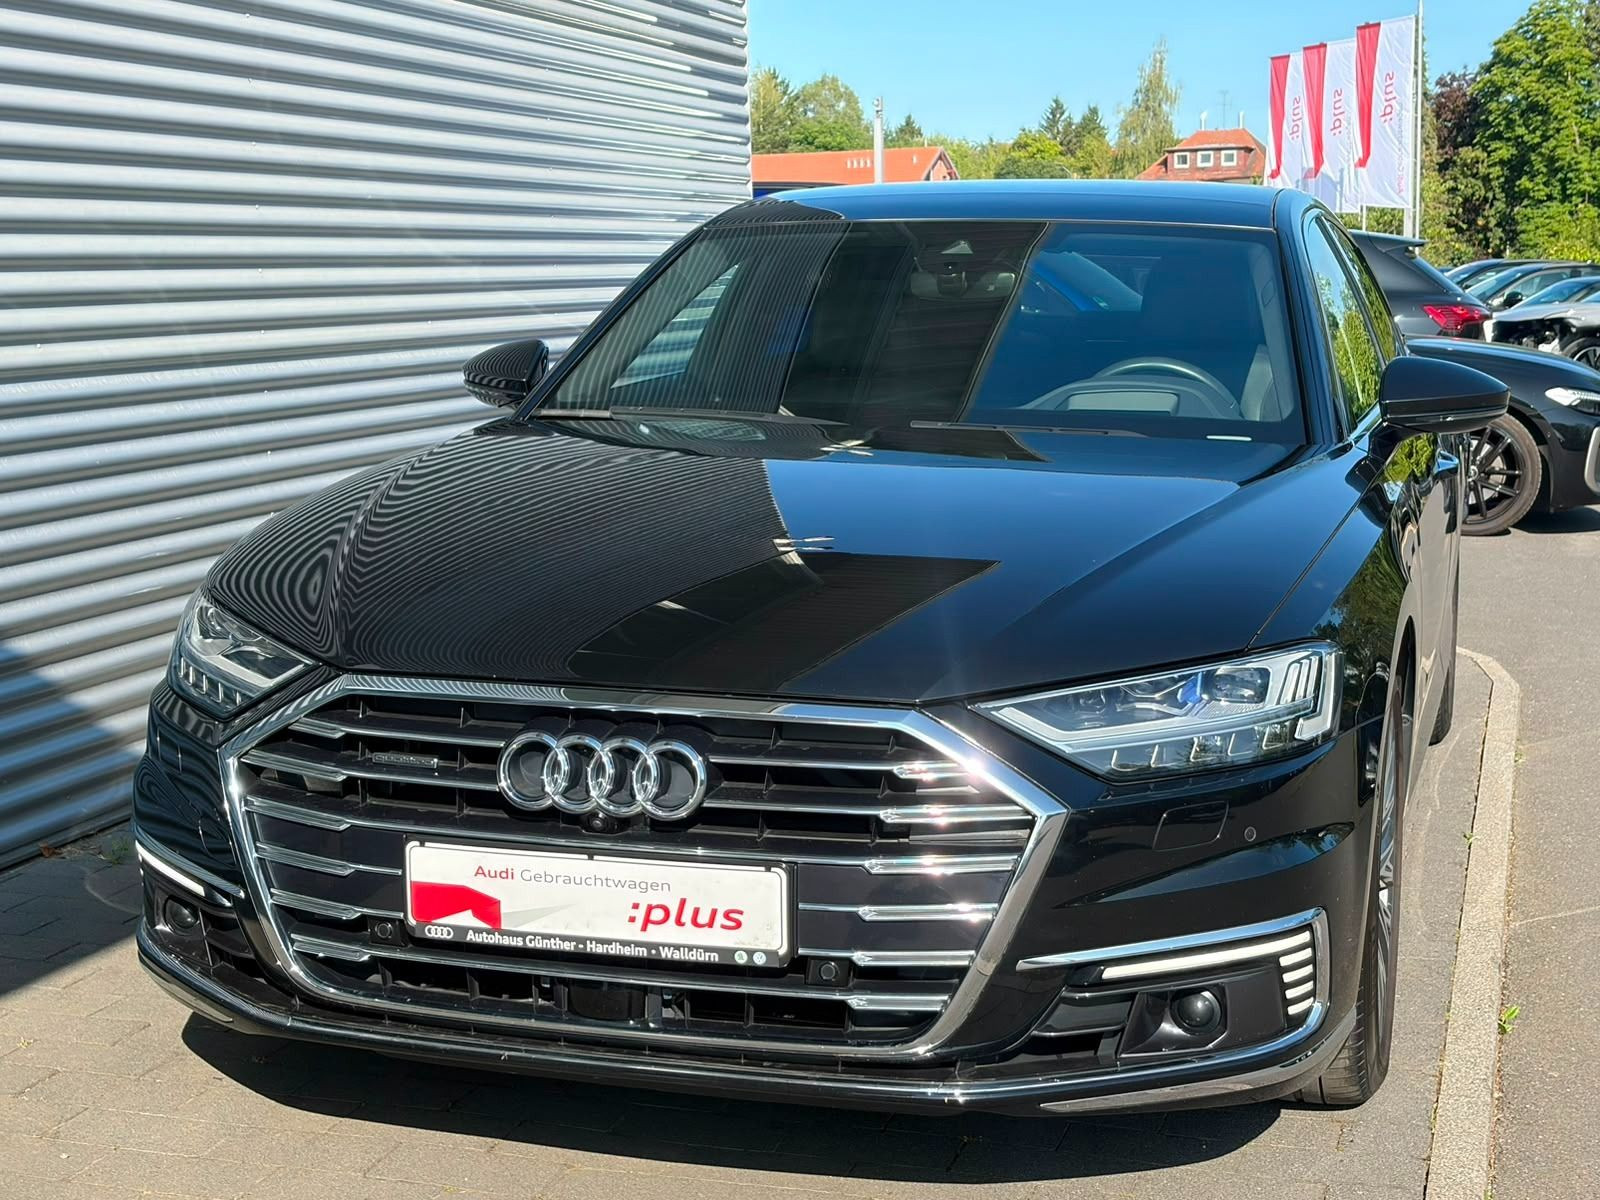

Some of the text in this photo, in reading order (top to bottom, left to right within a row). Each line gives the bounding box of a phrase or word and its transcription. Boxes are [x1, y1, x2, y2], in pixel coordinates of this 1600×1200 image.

[474, 865, 671, 893] Audi Gebrauchtwagen
[628, 898, 744, 932] :plus
[466, 929, 719, 962] Autohaus Günther Hardheim Walldürn
